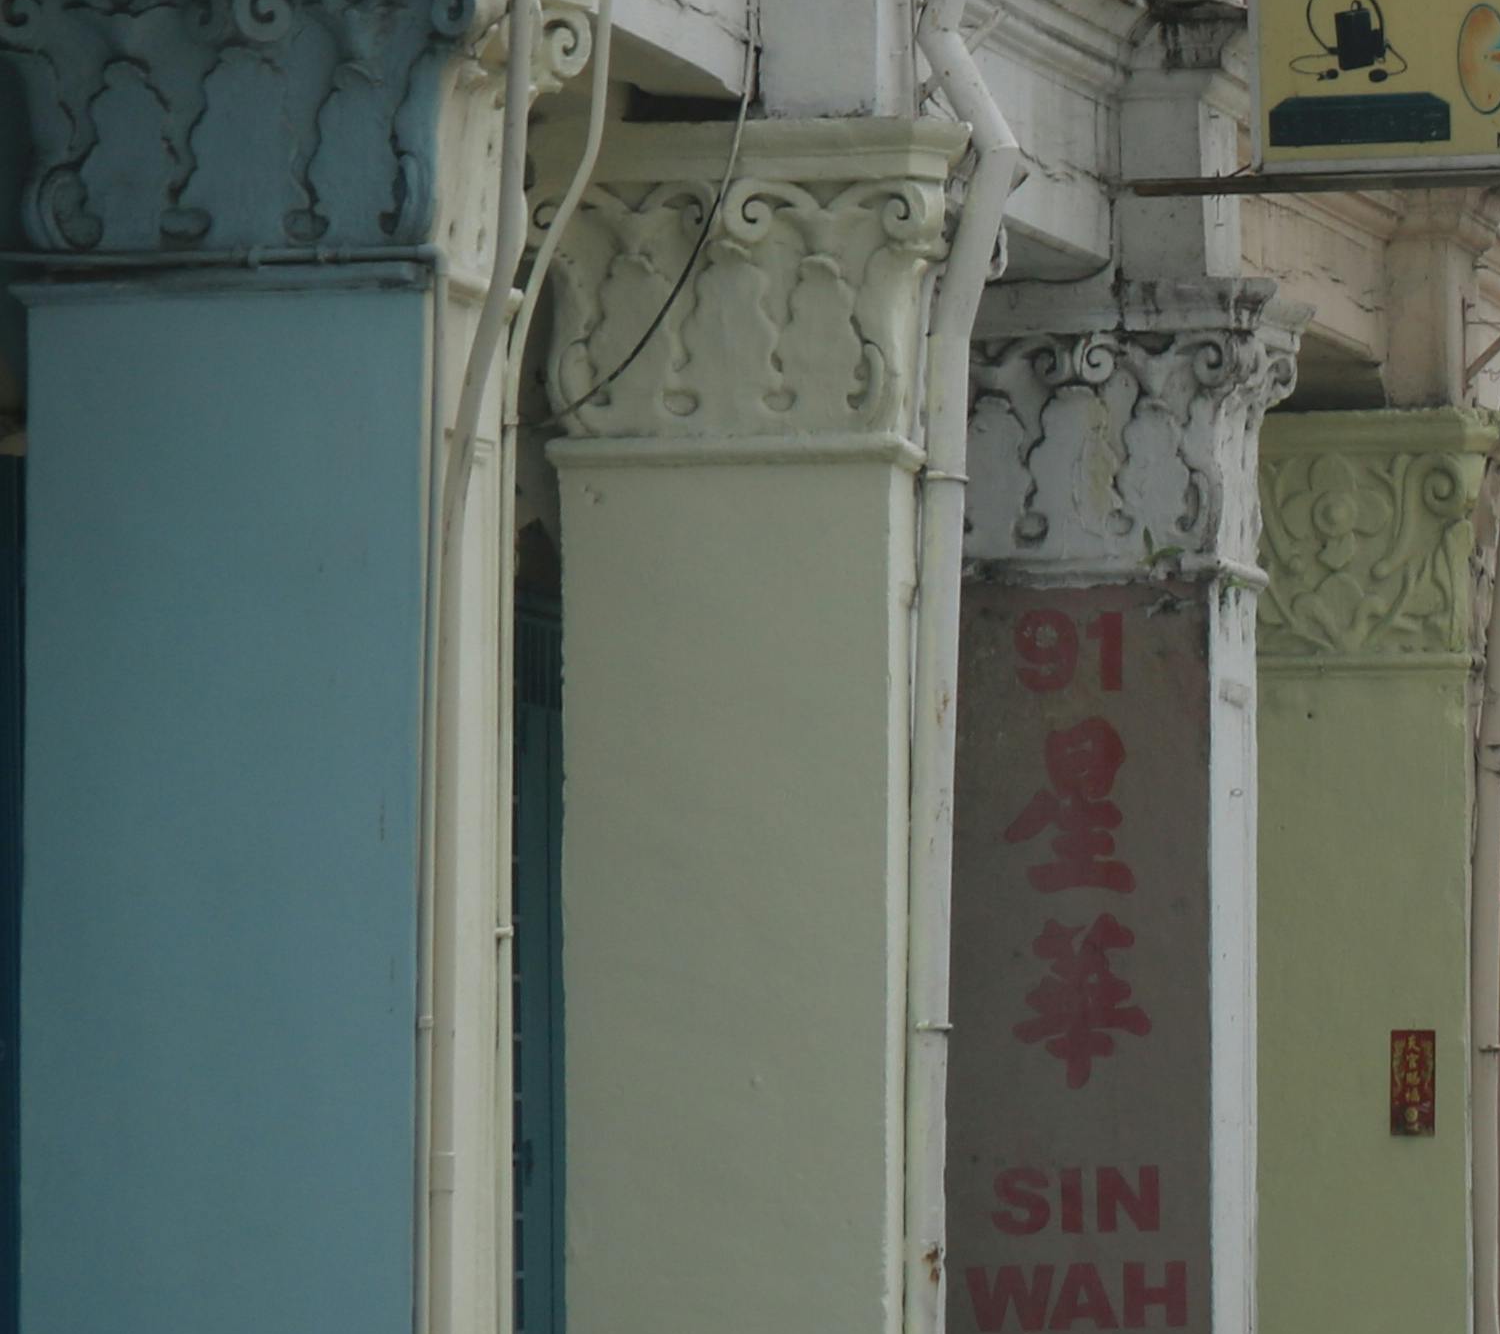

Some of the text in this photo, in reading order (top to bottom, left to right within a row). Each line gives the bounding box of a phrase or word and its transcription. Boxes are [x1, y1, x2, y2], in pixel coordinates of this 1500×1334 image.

[1014, 608, 1123, 693] 91
[991, 1166, 1161, 1236] SIN
[964, 1259, 1189, 1334] WAH
